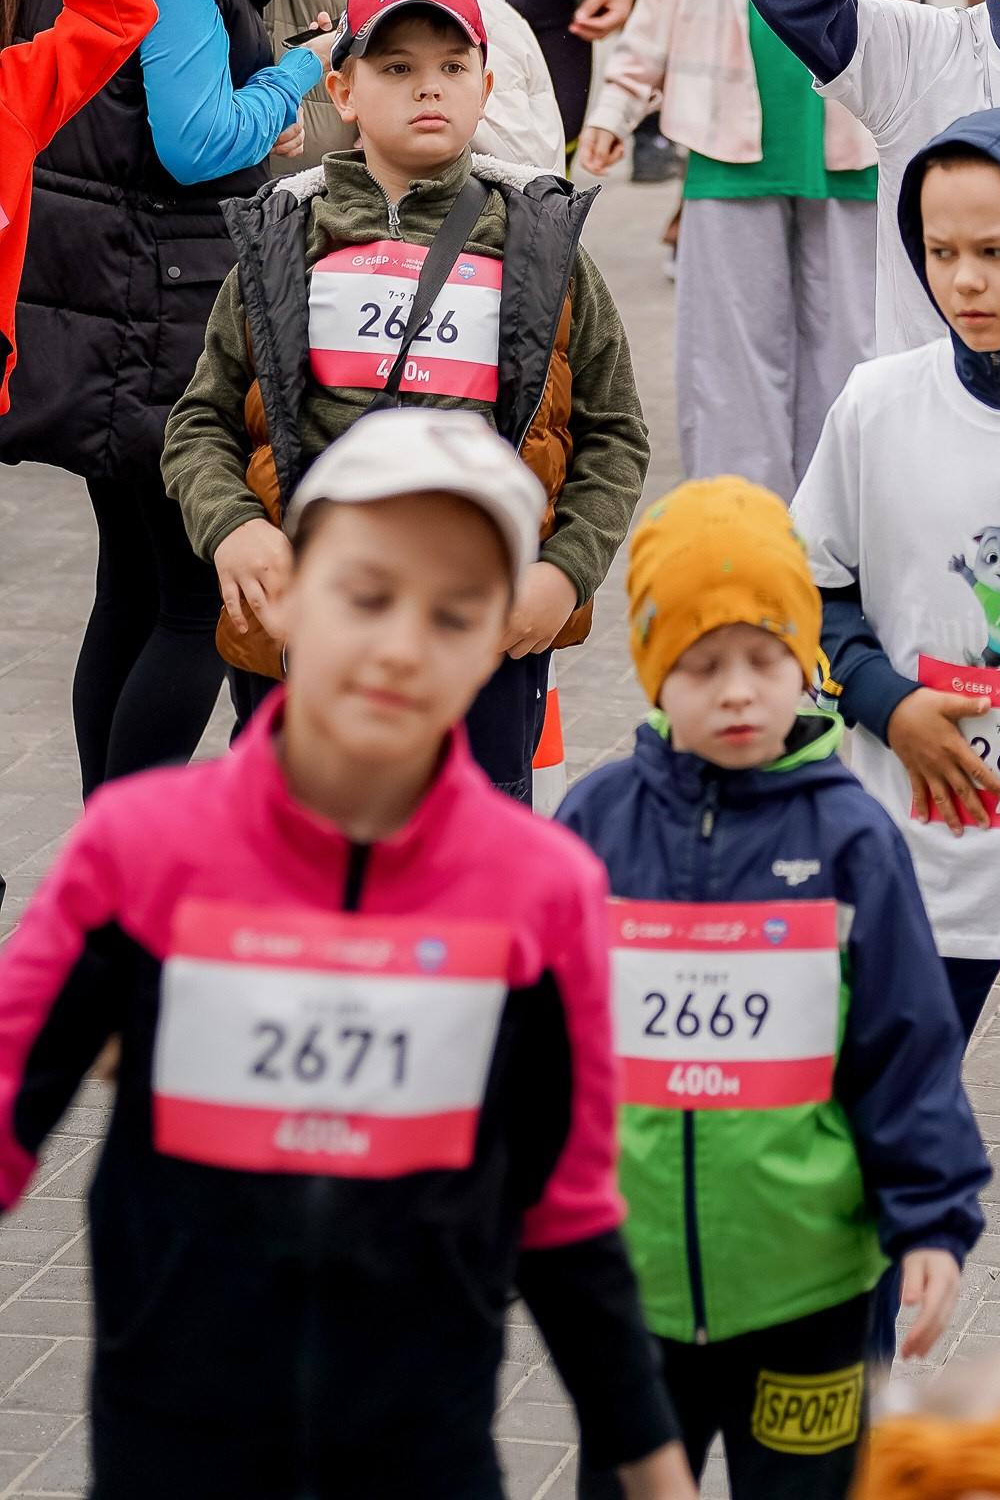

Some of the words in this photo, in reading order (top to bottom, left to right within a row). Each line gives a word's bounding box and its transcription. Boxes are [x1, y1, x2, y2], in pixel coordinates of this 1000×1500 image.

[364, 255, 390, 265] СБЕР
[388, 290, 406, 301] 7-9
[357, 302, 459, 344] 2626
[376, 358, 431, 382] 40м
[964, 681, 993, 695] СБЕР
[643, 992, 769, 1038] 2669
[249, 1019, 409, 1090] 2671
[667, 1065, 740, 1097] 400м
[765, 1387, 852, 1435] SPORT
